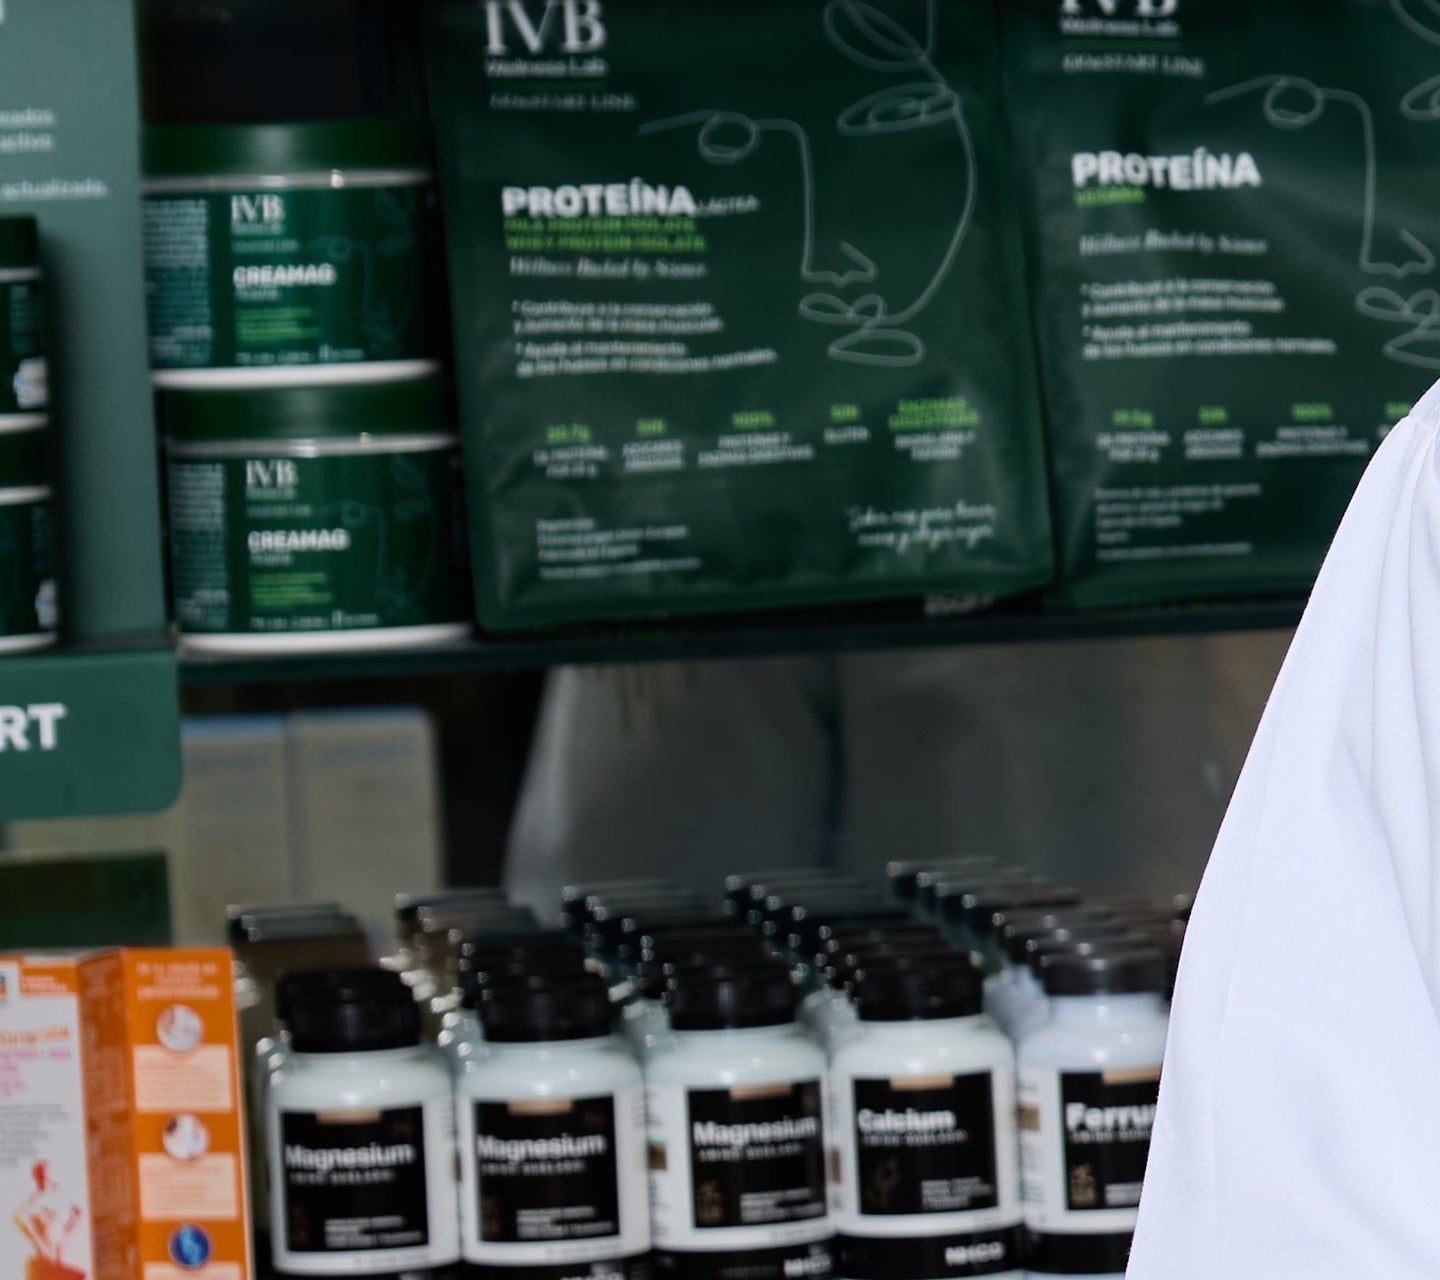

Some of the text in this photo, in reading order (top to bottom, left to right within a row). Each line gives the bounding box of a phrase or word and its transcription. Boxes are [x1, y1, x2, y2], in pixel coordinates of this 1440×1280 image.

[1071, 146, 1263, 191] PROTEÍNA
[230, 194, 286, 225] IVB
[501, 175, 698, 218] PROTEÍNA
[233, 262, 339, 288] CREAMAG
[245, 458, 299, 489] IVB
[247, 526, 352, 554] CREAMAG
[693, 1116, 820, 1148] Magnesium
[857, 1106, 957, 1135] Calcium
[285, 1141, 416, 1170] Magnesium
[477, 1132, 608, 1165] Magnesium
